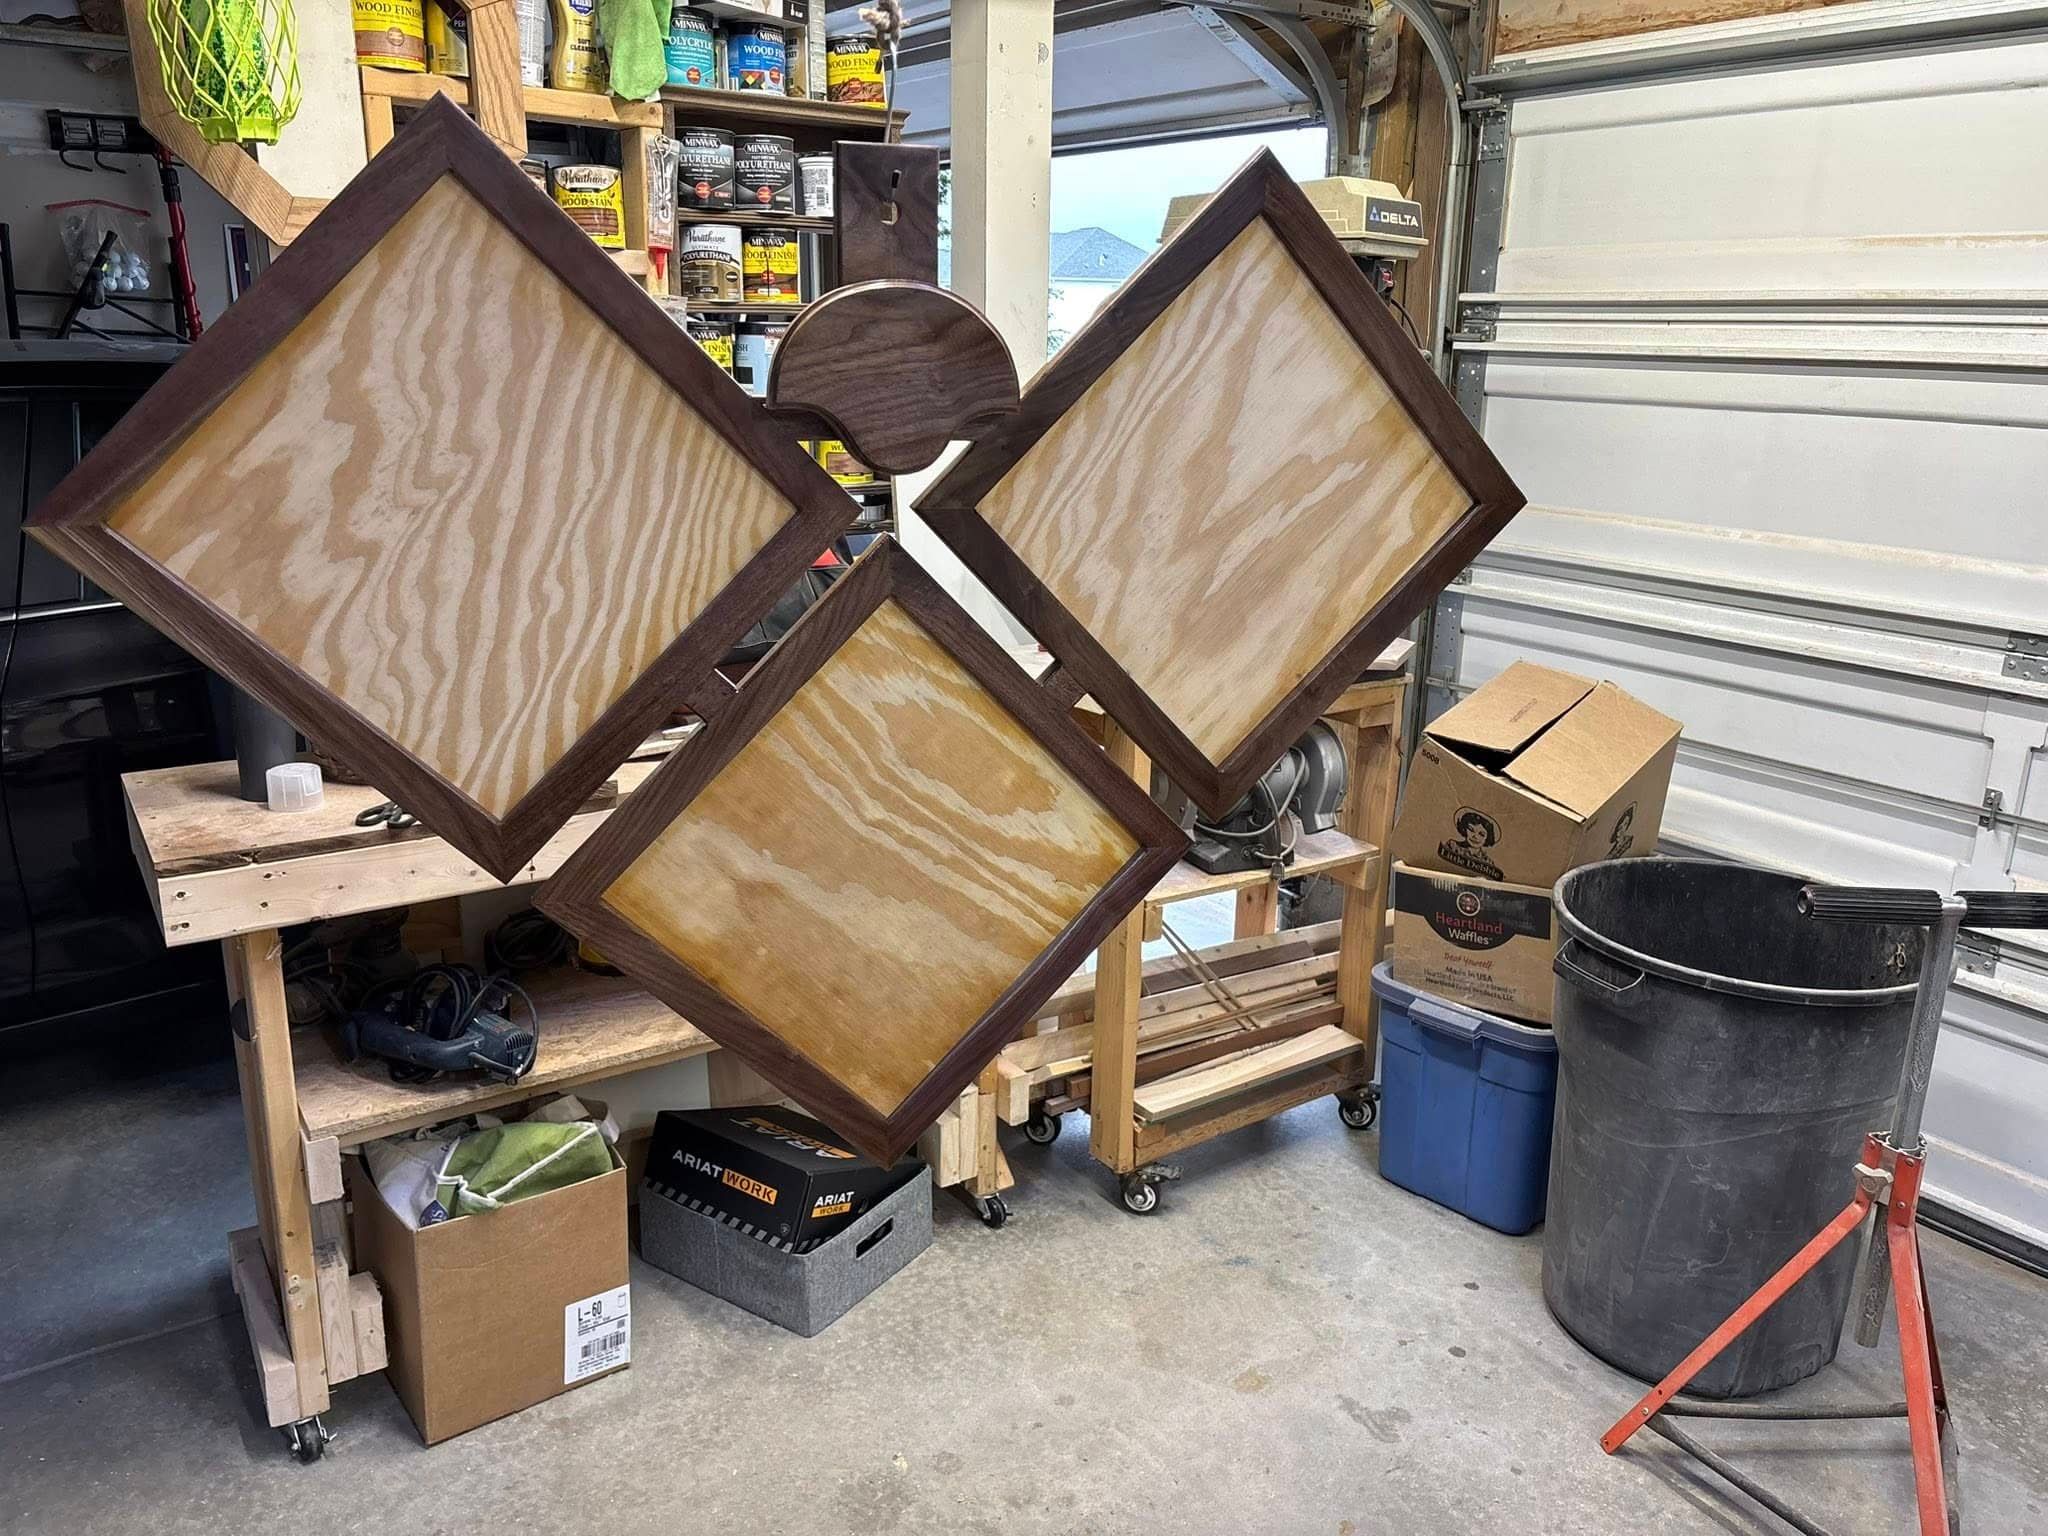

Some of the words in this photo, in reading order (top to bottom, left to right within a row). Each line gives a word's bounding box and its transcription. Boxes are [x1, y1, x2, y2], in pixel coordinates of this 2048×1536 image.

[355, 1, 392, 12] WOOD
[744, 45, 774, 56] WOOD
[836, 45, 868, 54] MINWAX
[685, 138, 719, 148] MINWAX
[747, 144, 780, 154] MINWAX
[590, 198, 613, 207] STAIN
[1380, 211, 1419, 227] DELTA
[751, 237, 784, 246] MINWAX
[1466, 859, 1500, 878] Debbie
[1435, 911, 1505, 935] Heartland
[1448, 927, 1489, 945] Waffles
[1476, 973, 1493, 982] USA
[672, 1149, 722, 1178] ARIAT
[726, 1170, 774, 1202] WORK
[814, 1191, 854, 1207] ARIAT
[820, 1206, 844, 1215] WORK
